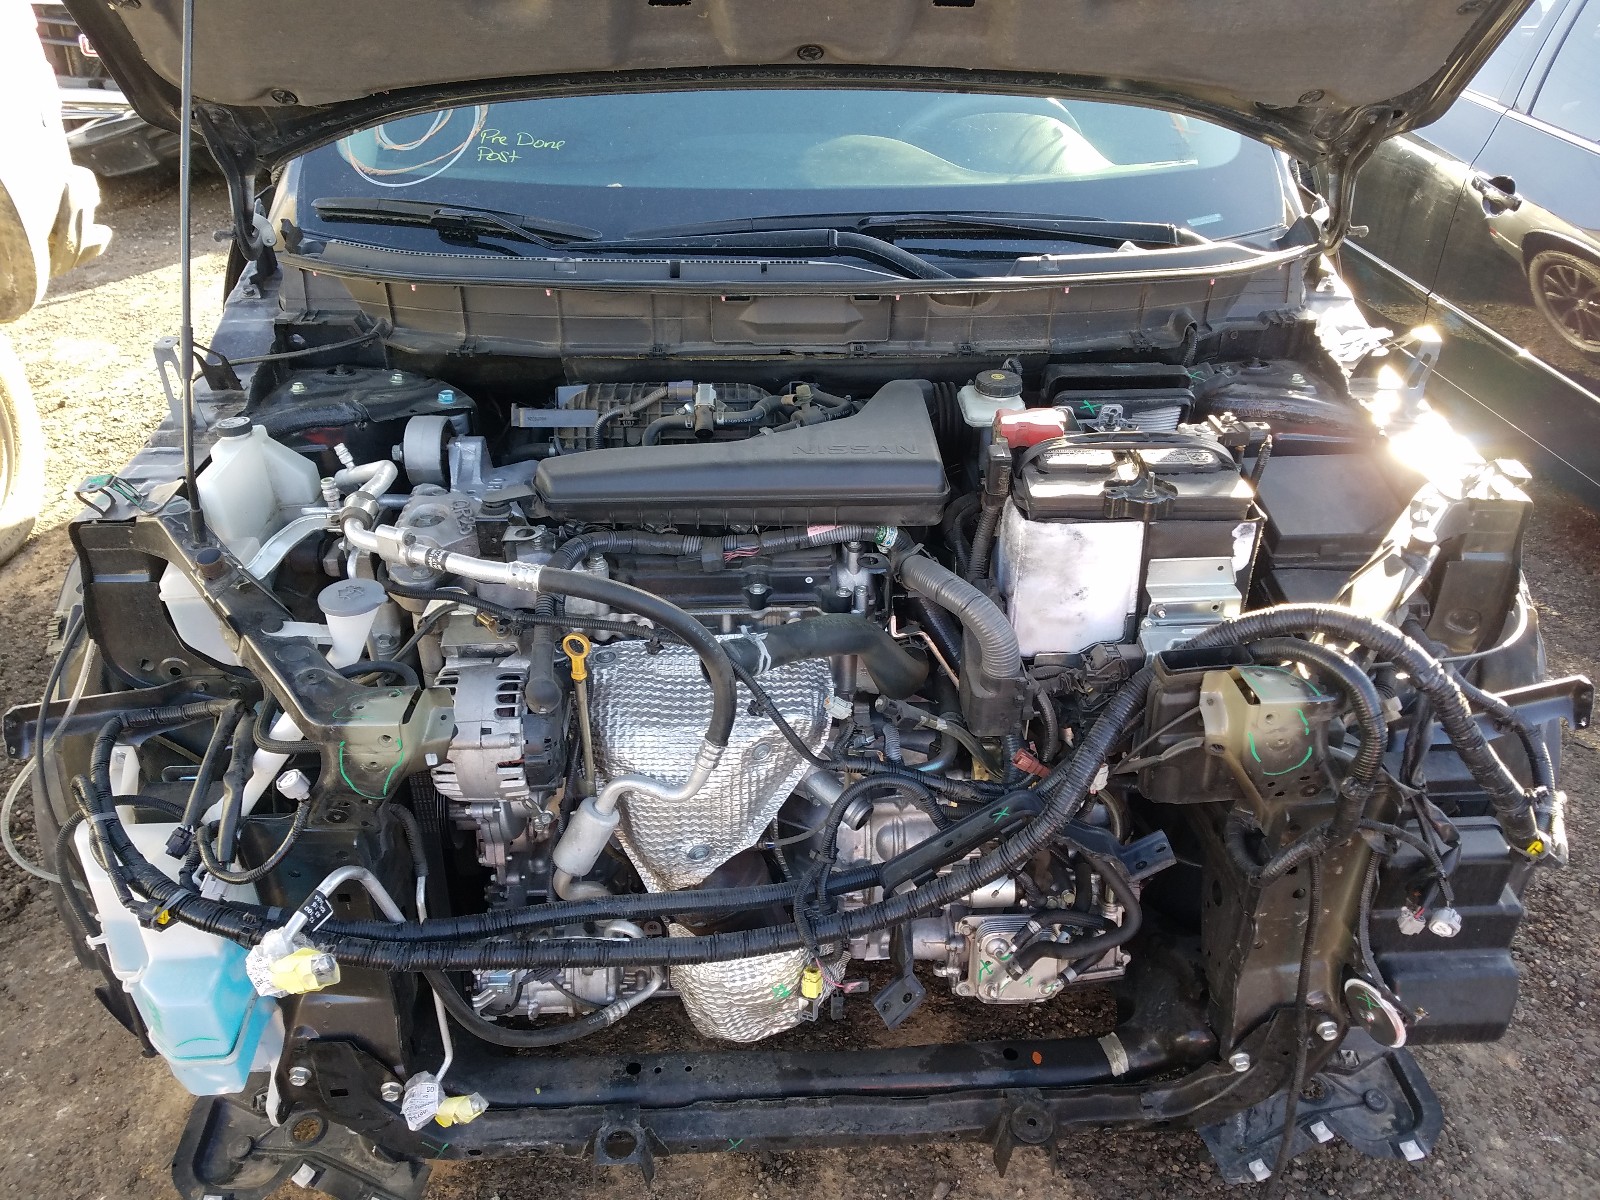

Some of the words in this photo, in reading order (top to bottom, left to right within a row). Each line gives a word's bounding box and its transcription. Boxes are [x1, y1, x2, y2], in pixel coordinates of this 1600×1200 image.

[480, 128, 509, 146] Pre
[516, 131, 566, 150] Done
[477, 146, 522, 163] Post
[792, 445, 920, 455] NISSAN
